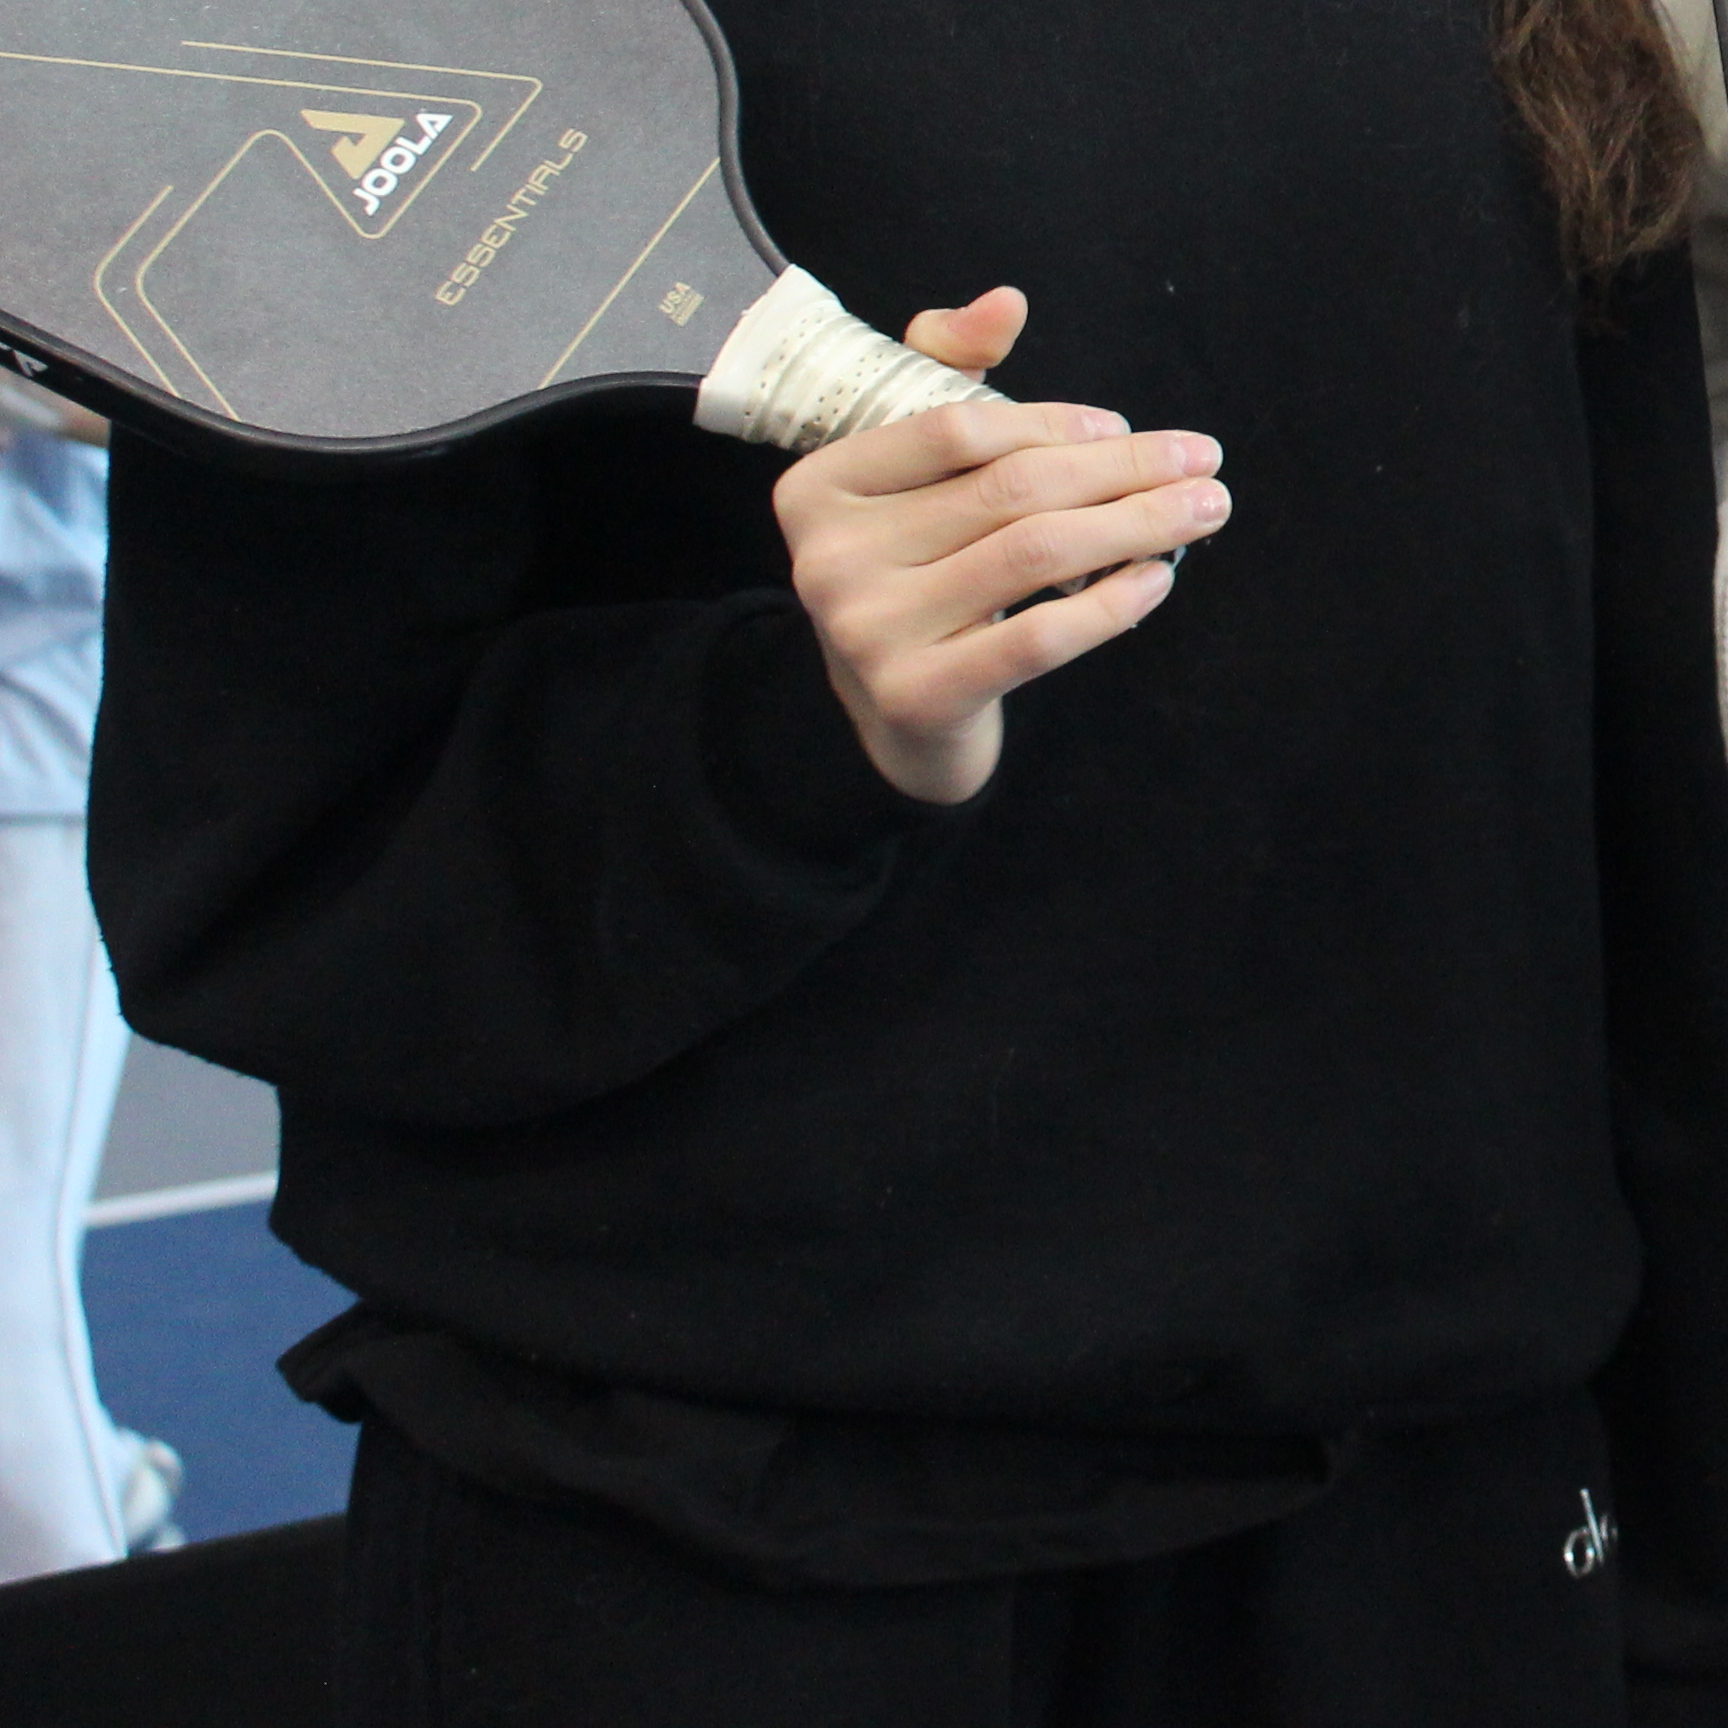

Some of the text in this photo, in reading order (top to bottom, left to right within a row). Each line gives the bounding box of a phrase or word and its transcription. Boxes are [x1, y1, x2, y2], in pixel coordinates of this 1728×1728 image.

[352, 112, 454, 216] JOOLA
[434, 128, 589, 306] ESSENTIALS
[657, 281, 693, 314] USA
